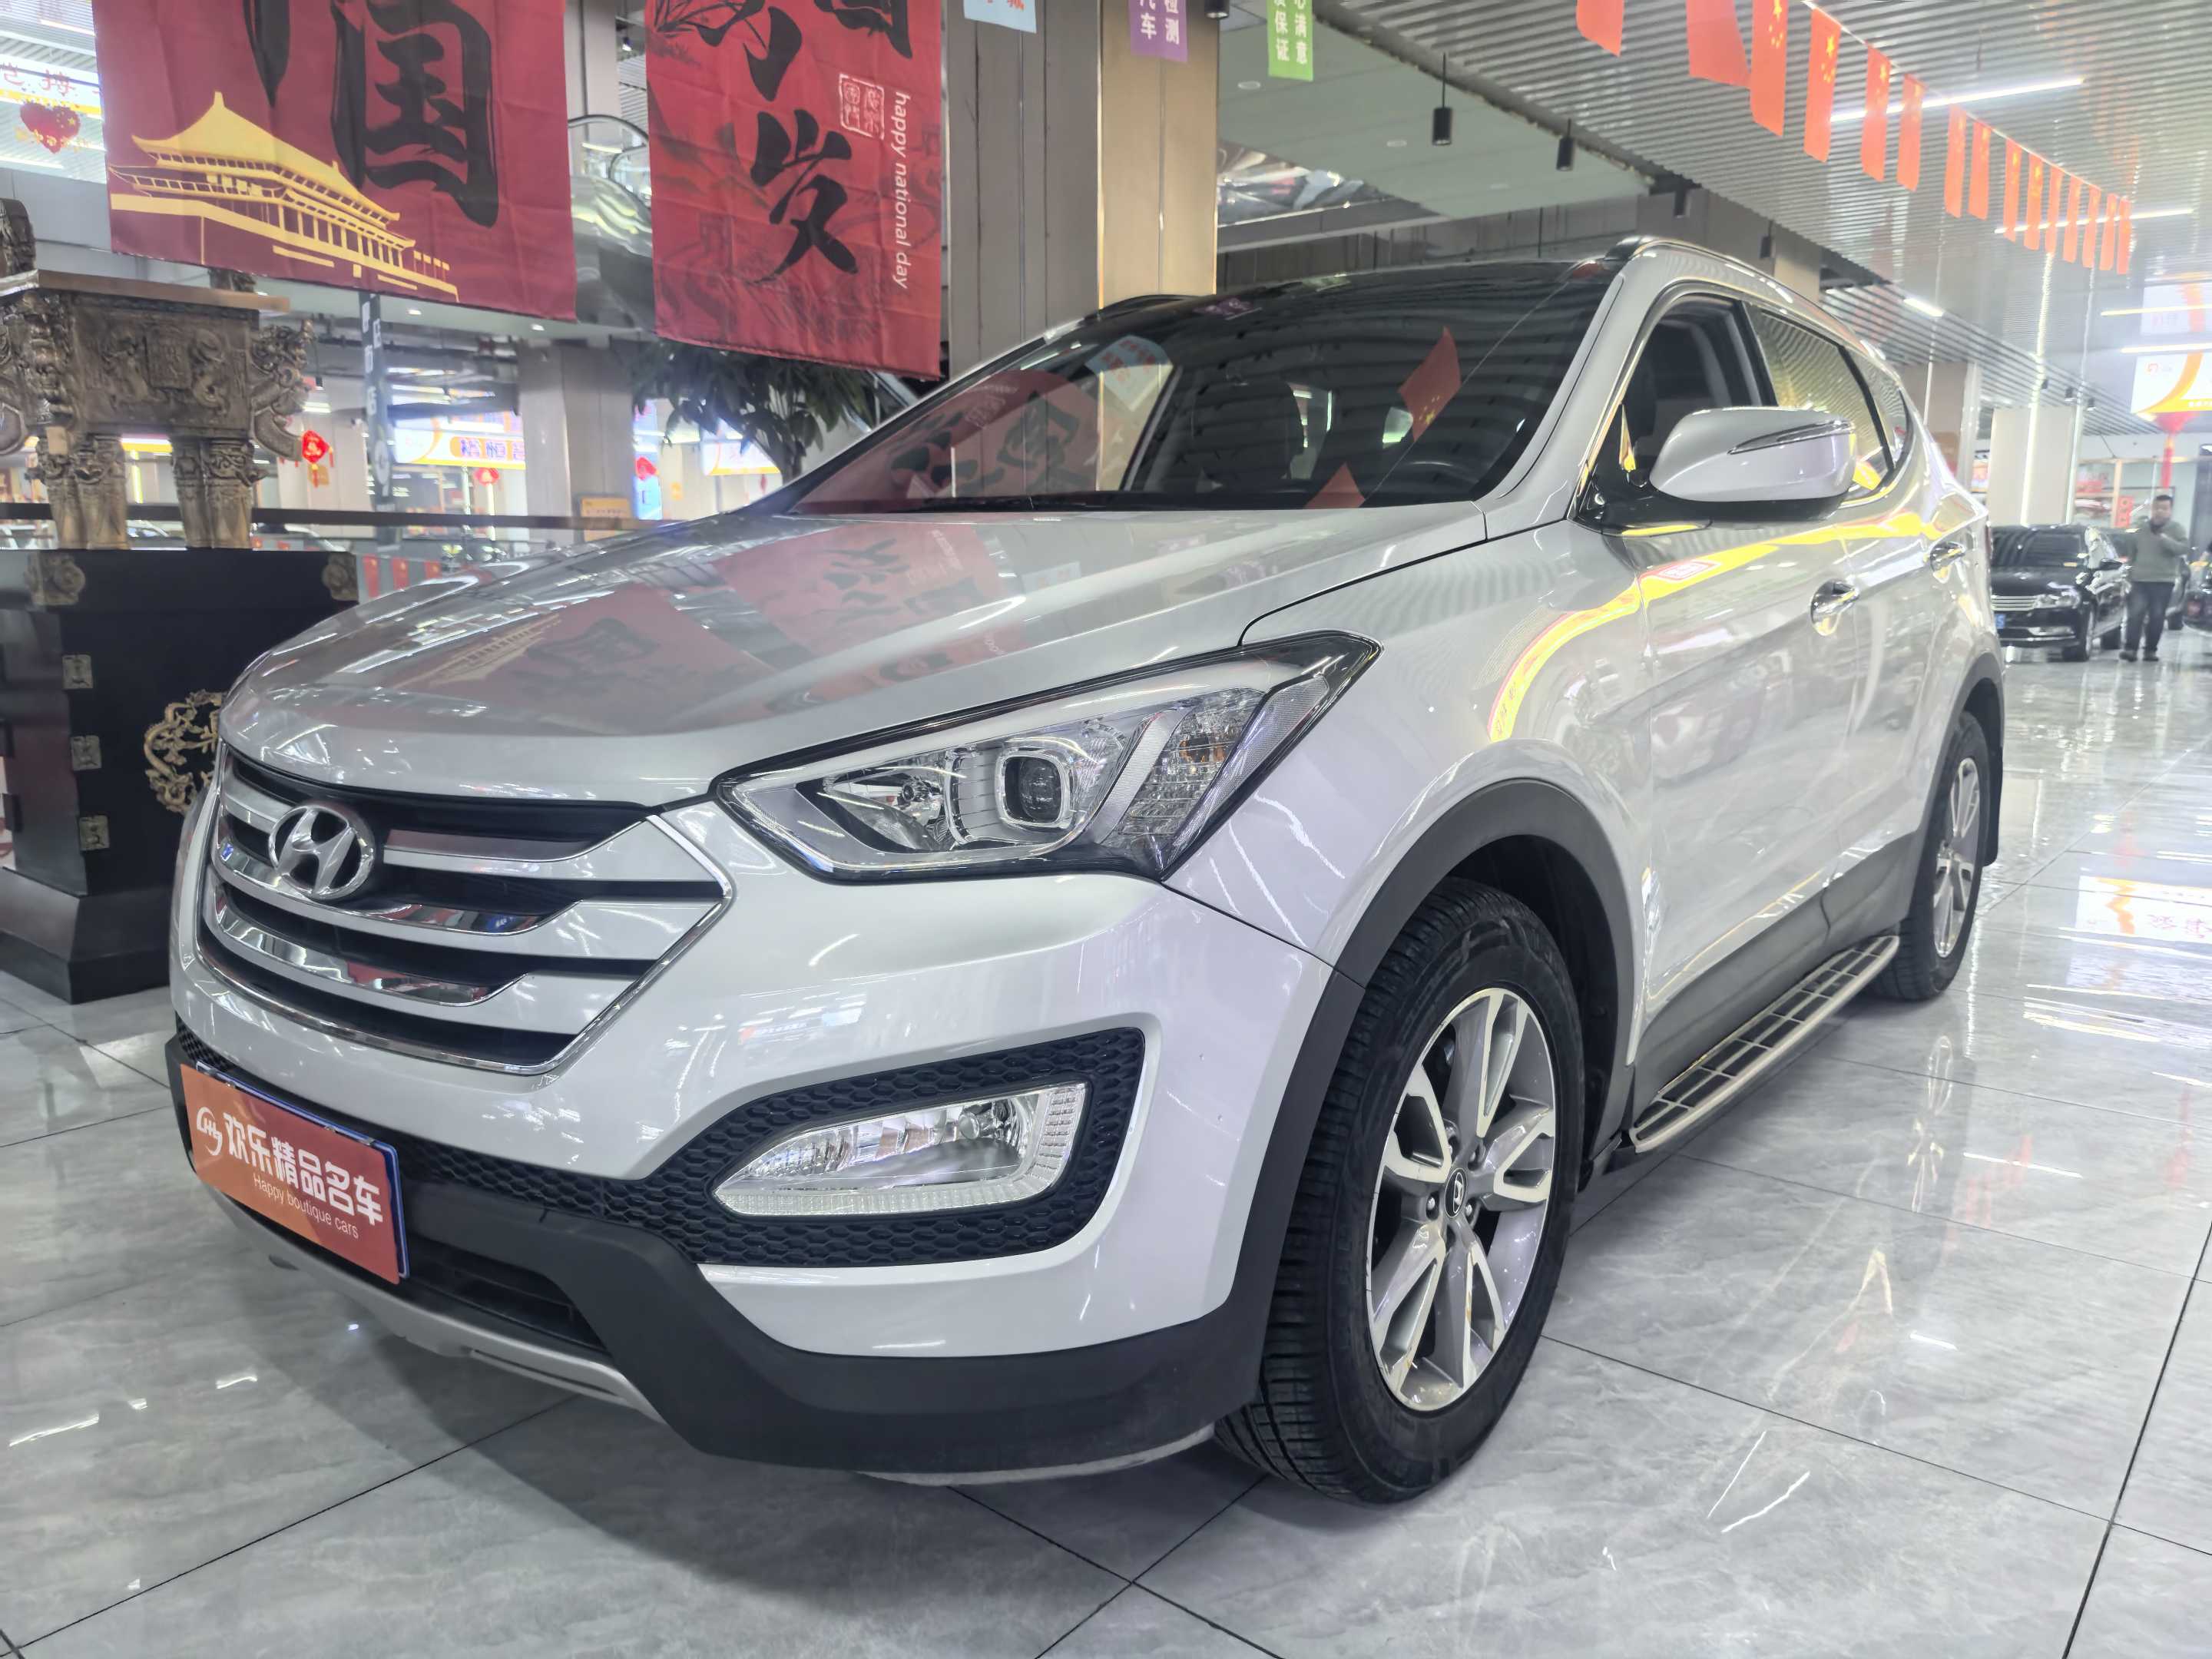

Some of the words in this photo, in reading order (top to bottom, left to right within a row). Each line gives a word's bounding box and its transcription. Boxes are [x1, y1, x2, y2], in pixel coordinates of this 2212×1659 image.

[890, 91, 911, 158] happy
[894, 161, 912, 247] national
[892, 250, 912, 290] day
[223, 1111, 383, 1227] 欢乐精品名车
[253, 1173, 285, 1204] Happy
[286, 1190, 332, 1226] boutique
[334, 1216, 359, 1240] cars
